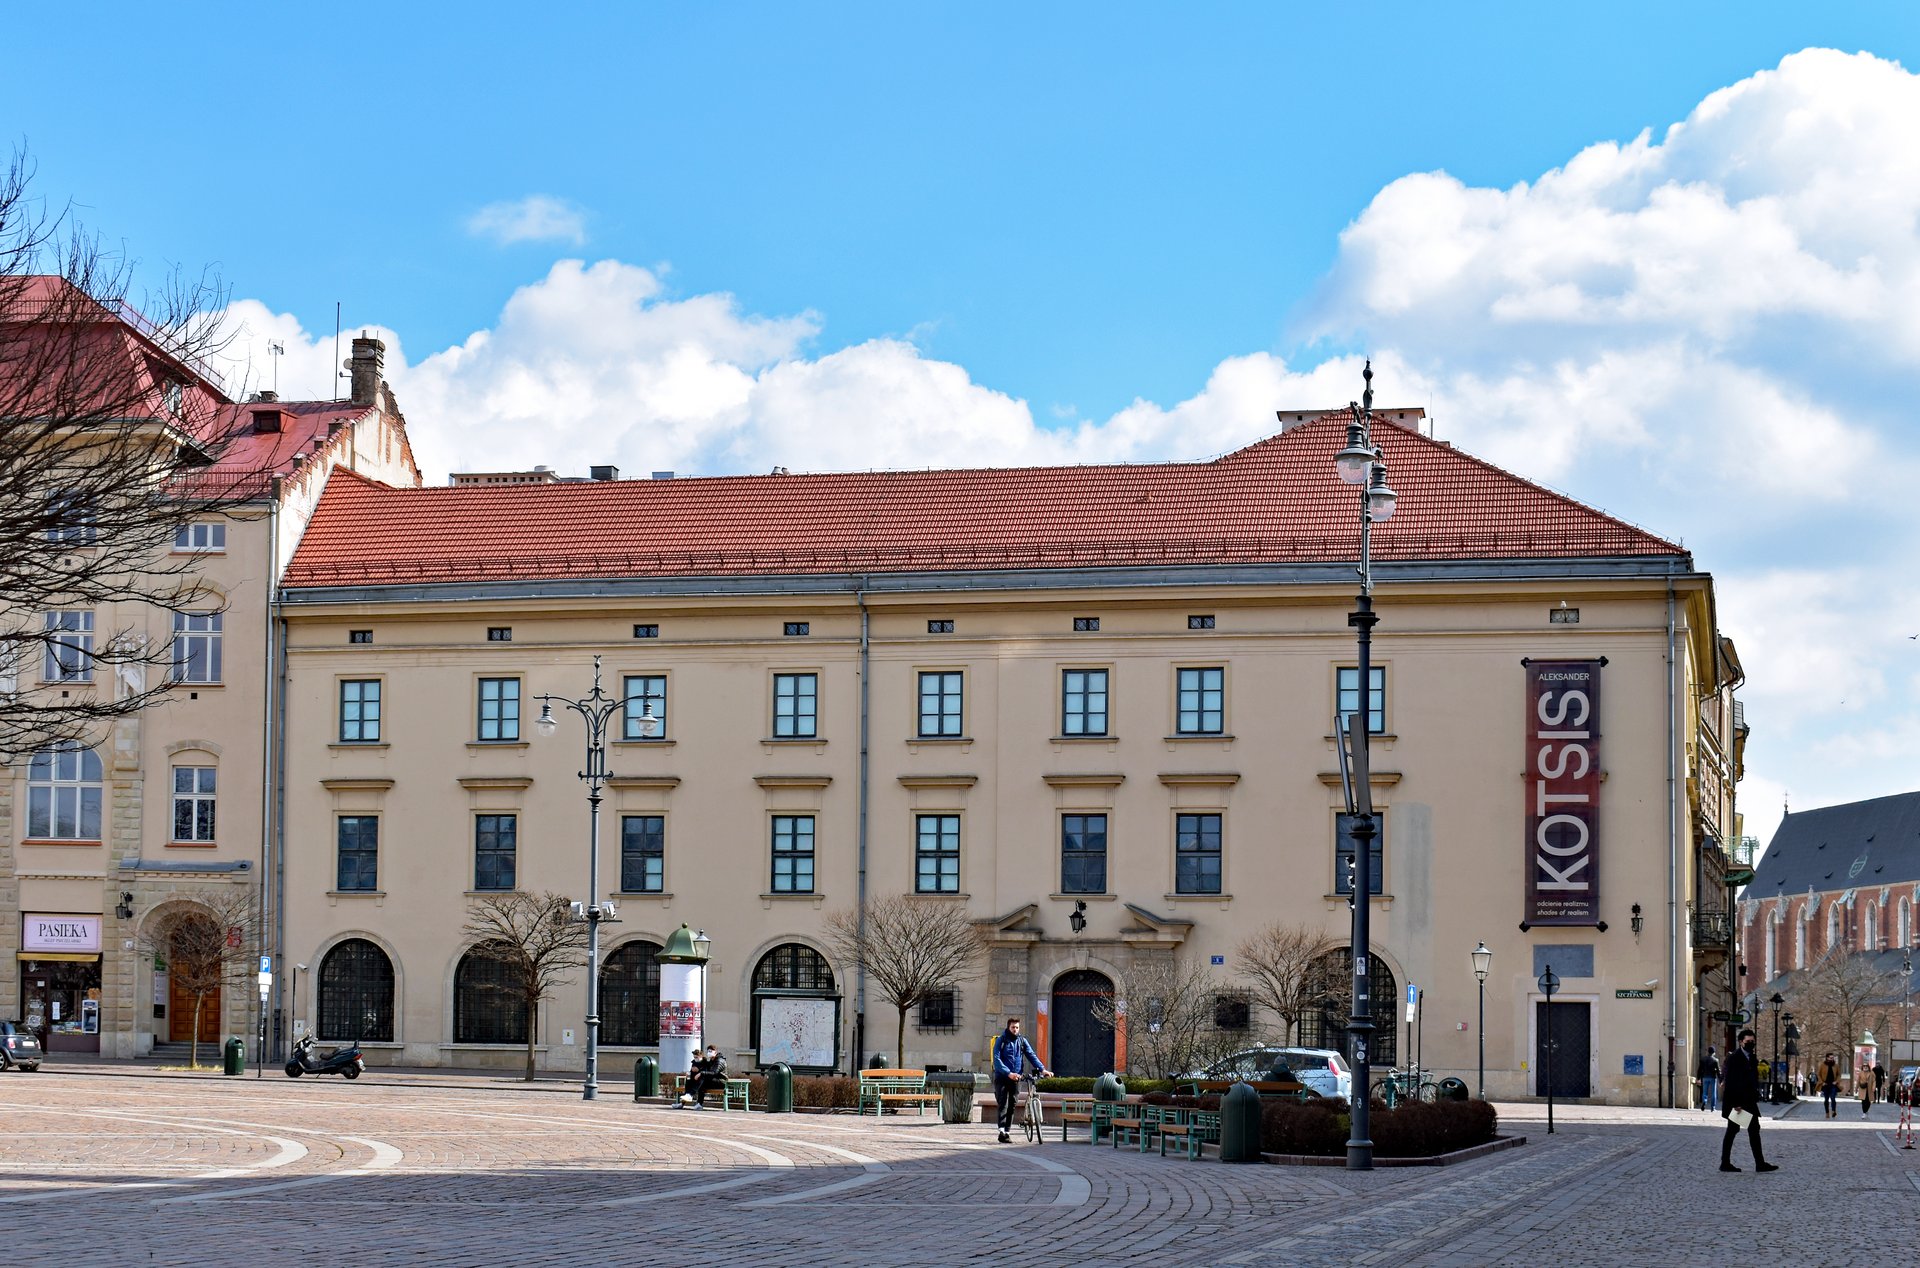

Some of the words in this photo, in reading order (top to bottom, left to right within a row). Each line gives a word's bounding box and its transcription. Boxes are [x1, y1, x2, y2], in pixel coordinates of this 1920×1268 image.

[1538, 672, 1590, 681] ALEKSANDER
[1537, 689, 1590, 891] KOTSIS
[39, 923, 88, 938] PASIEKA
